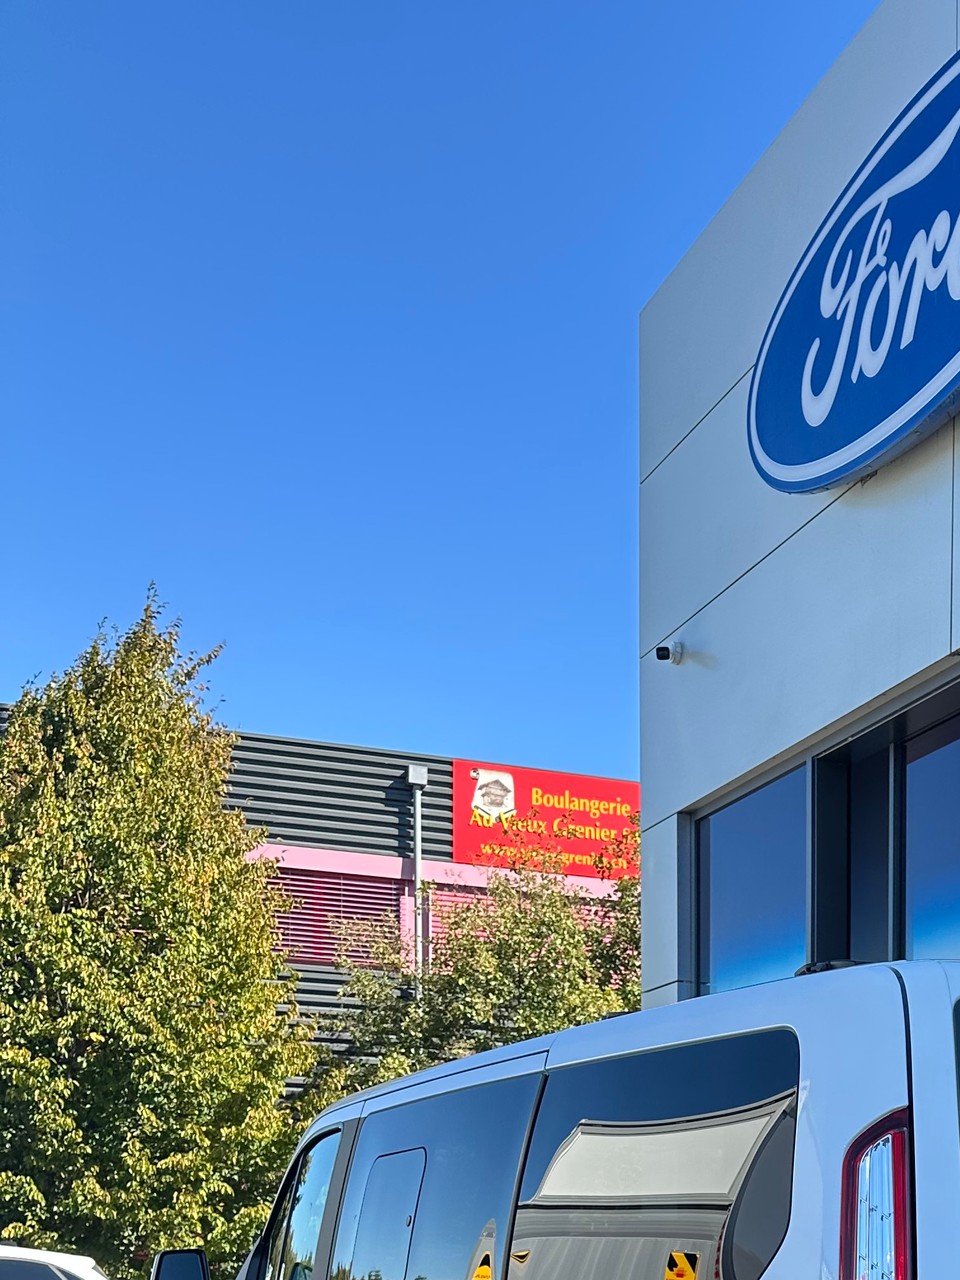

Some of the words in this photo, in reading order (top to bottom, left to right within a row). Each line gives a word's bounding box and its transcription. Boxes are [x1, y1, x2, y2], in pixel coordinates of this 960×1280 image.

[531, 787, 631, 818] Boulangerie
[469, 808, 493, 829] Au
[499, 809, 548, 834] Vieux
[553, 818, 618, 842] Grenier
